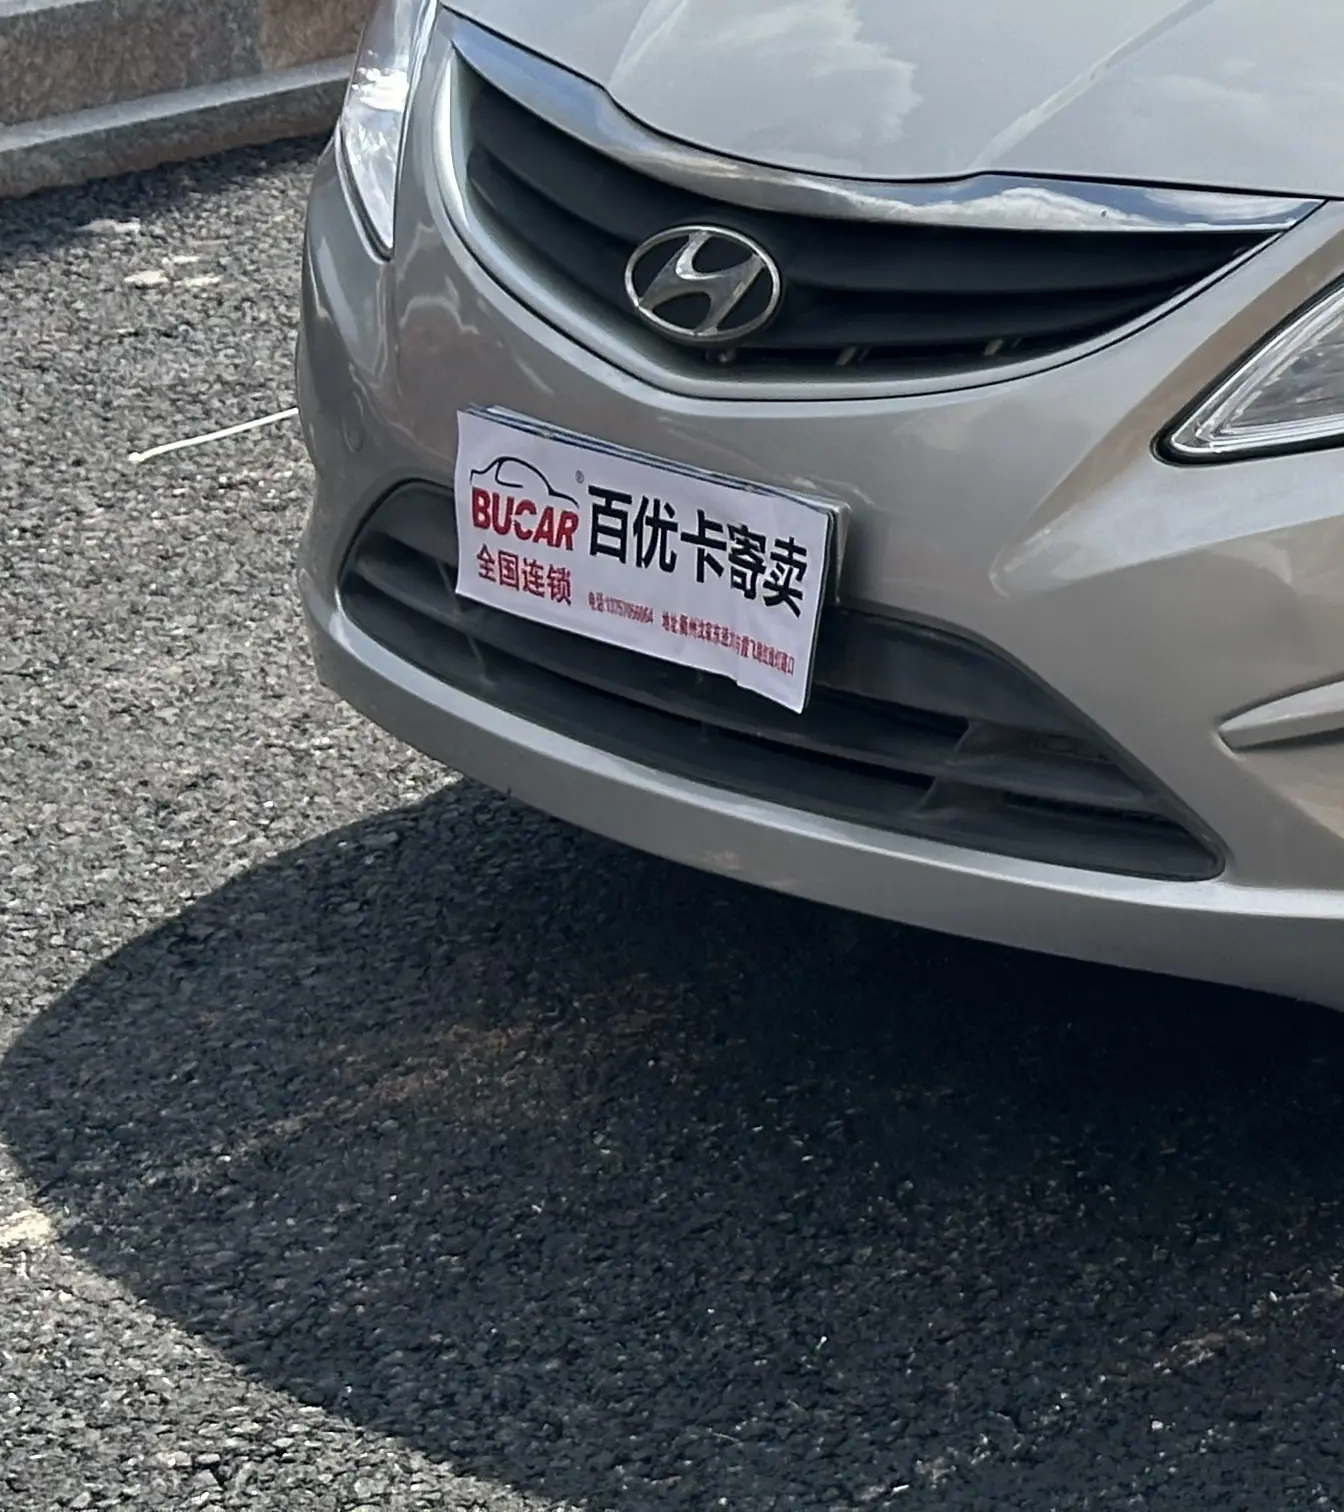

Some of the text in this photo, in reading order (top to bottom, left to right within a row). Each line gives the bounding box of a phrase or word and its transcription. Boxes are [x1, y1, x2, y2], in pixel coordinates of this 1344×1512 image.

[471, 486, 579, 551] BUCAR
[476, 544, 572, 606] 全国连锁
[588, 485, 808, 618] 百优卡寄卖
